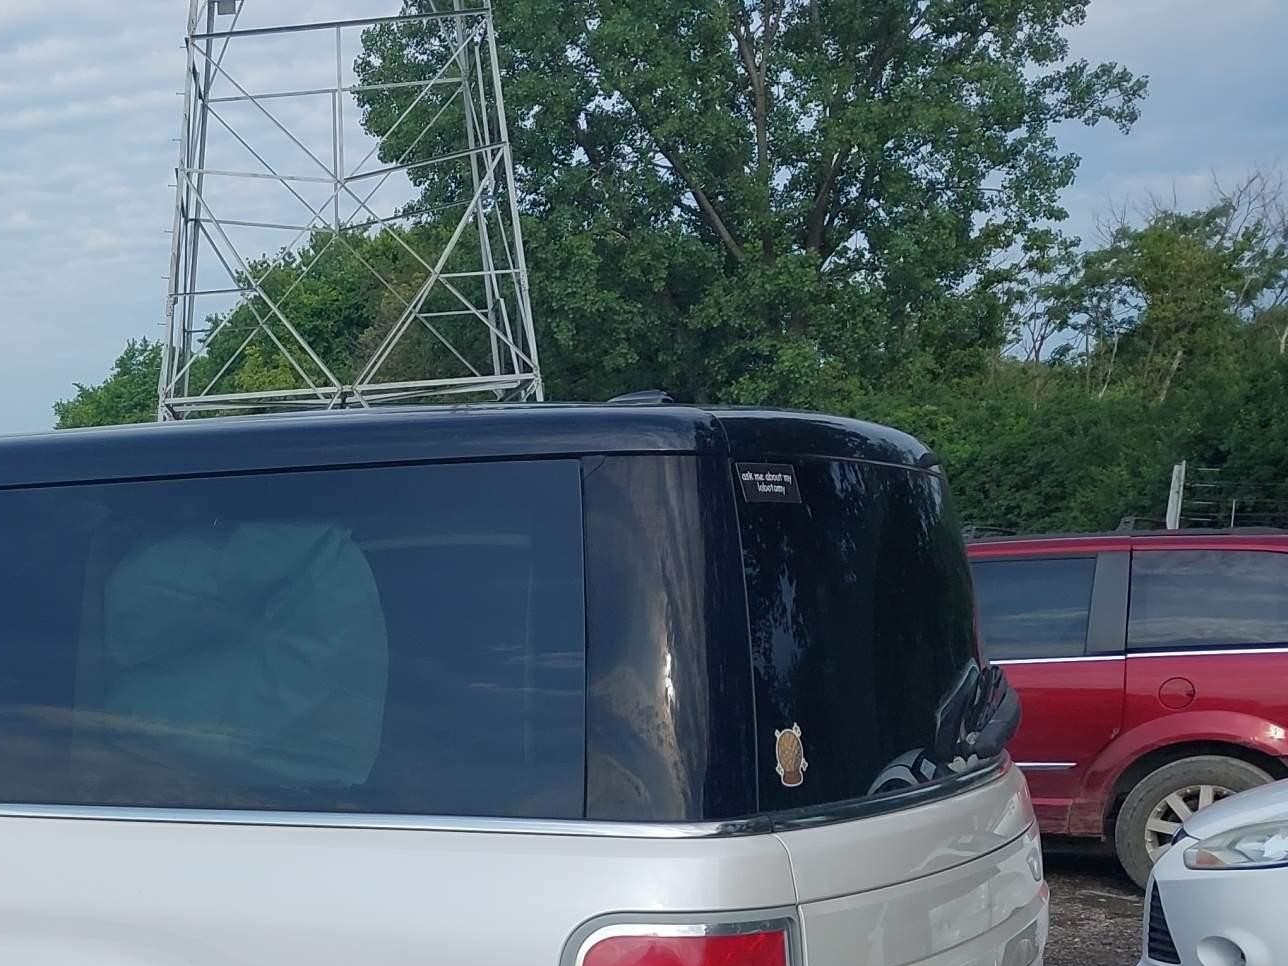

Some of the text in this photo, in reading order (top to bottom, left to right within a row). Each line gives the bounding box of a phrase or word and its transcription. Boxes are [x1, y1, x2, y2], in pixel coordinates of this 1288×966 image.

[742, 471, 753, 481] ask
[754, 473, 764, 481] me
[765, 471, 782, 481] about
[757, 482, 785, 496] lobotomy
